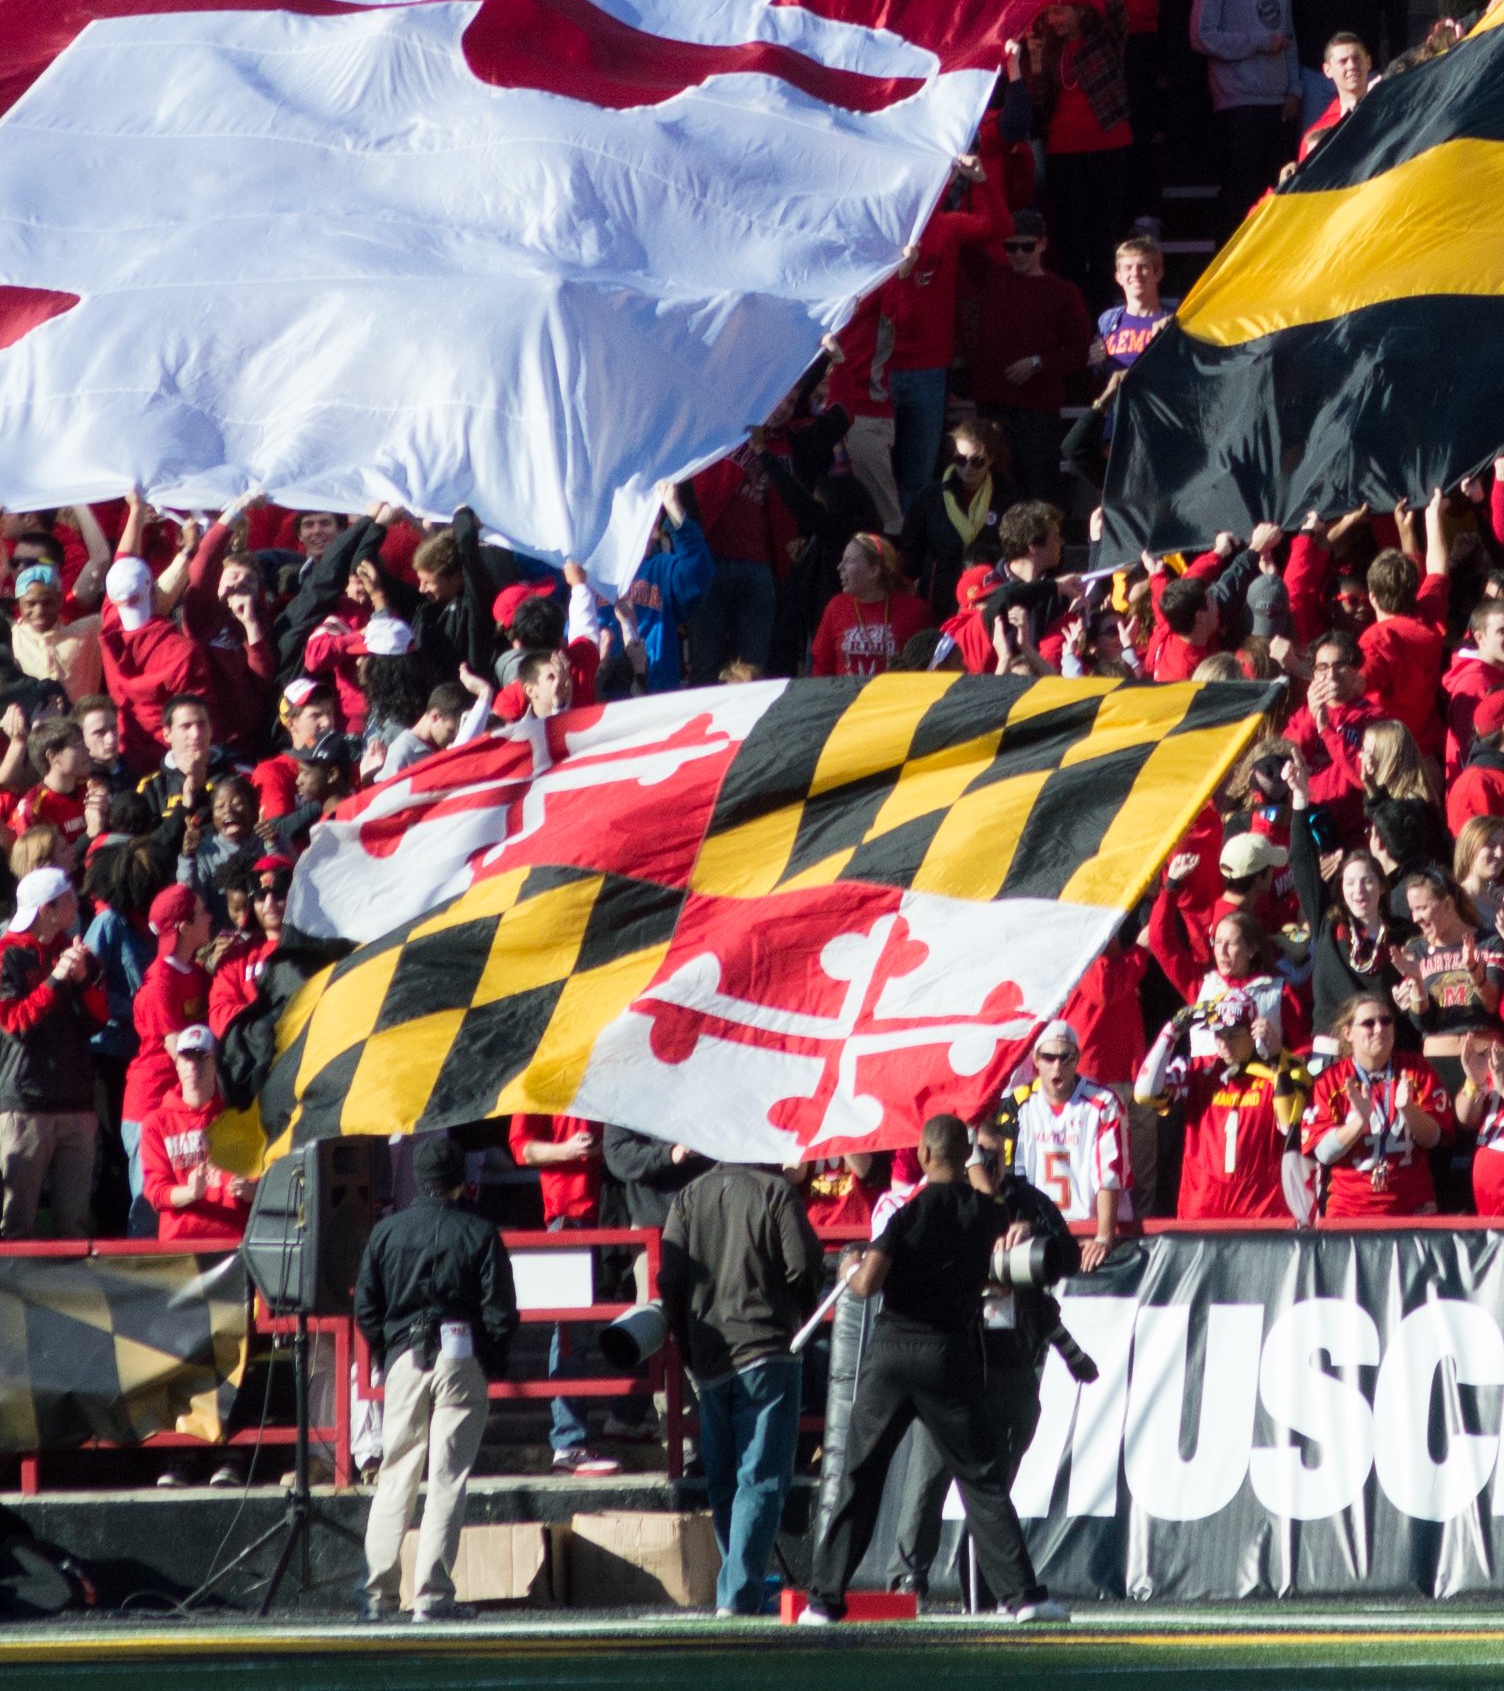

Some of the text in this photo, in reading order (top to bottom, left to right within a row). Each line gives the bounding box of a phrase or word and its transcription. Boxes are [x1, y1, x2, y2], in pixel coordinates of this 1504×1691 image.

[1443, 986, 1467, 1007] M
[1210, 1091, 1261, 1108] MARYLAND
[1034, 1134, 1082, 1153] MARYLAND
[1223, 1110, 1238, 1174] 1
[1042, 1152, 1072, 1210] 5
